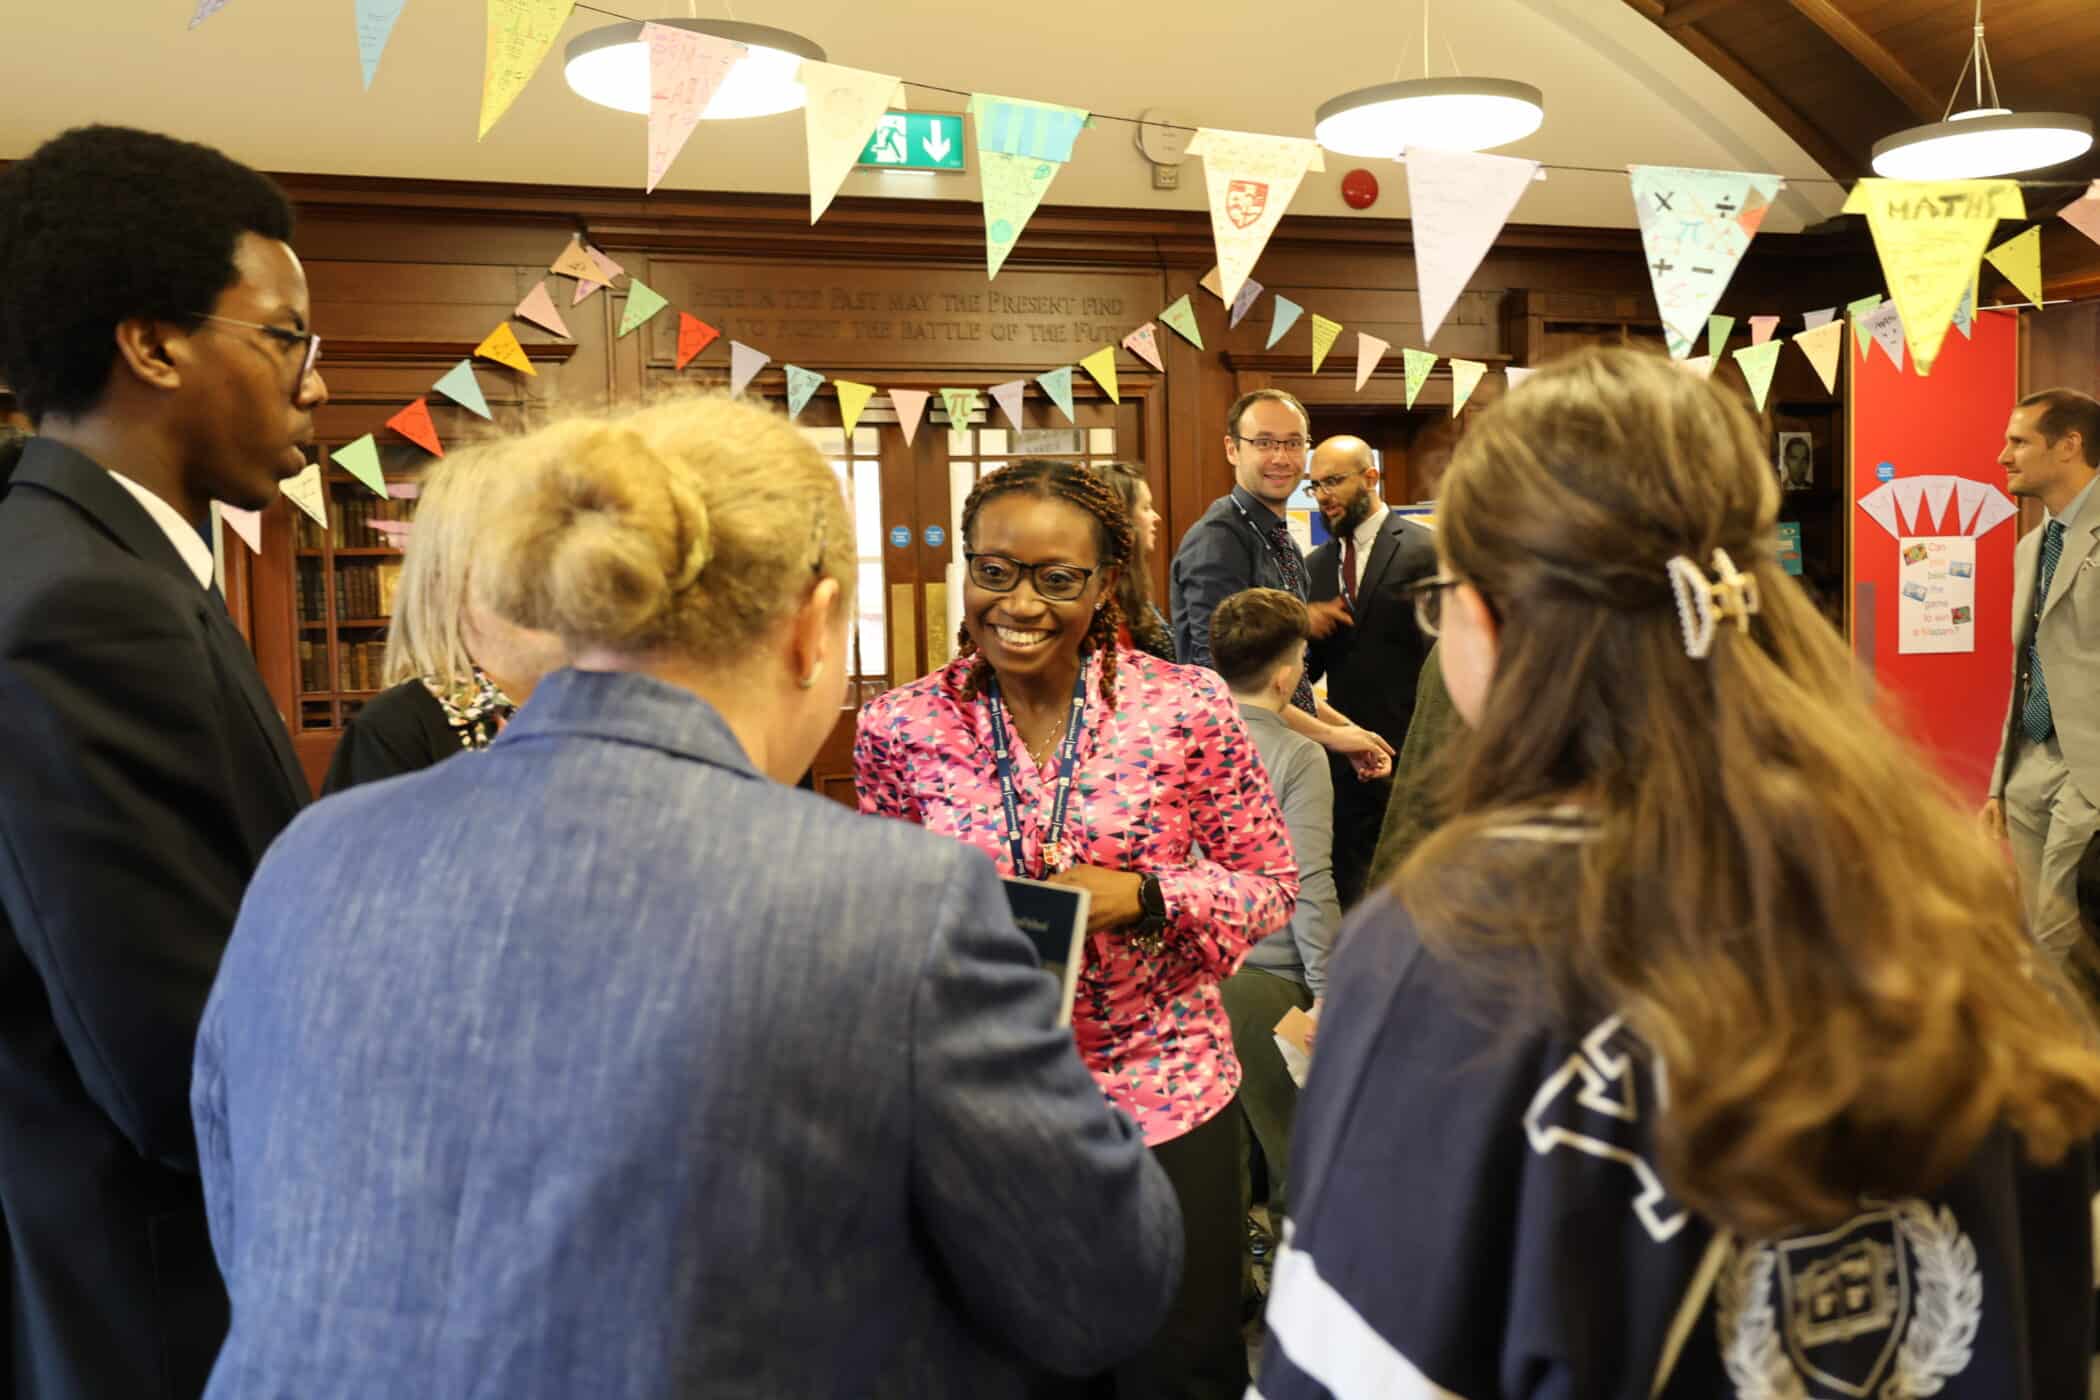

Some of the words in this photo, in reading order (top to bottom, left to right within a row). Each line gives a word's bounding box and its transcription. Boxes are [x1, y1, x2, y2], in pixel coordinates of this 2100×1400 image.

[1887, 185, 2005, 219] MATHS
[943, 293, 980, 313] THE
[987, 289, 1079, 315] PRESENT
[1082, 295, 1125, 316] FIND
[902, 320, 980, 341] BATTLE
[990, 322, 1017, 341] OF
[1025, 322, 1067, 342] THE
